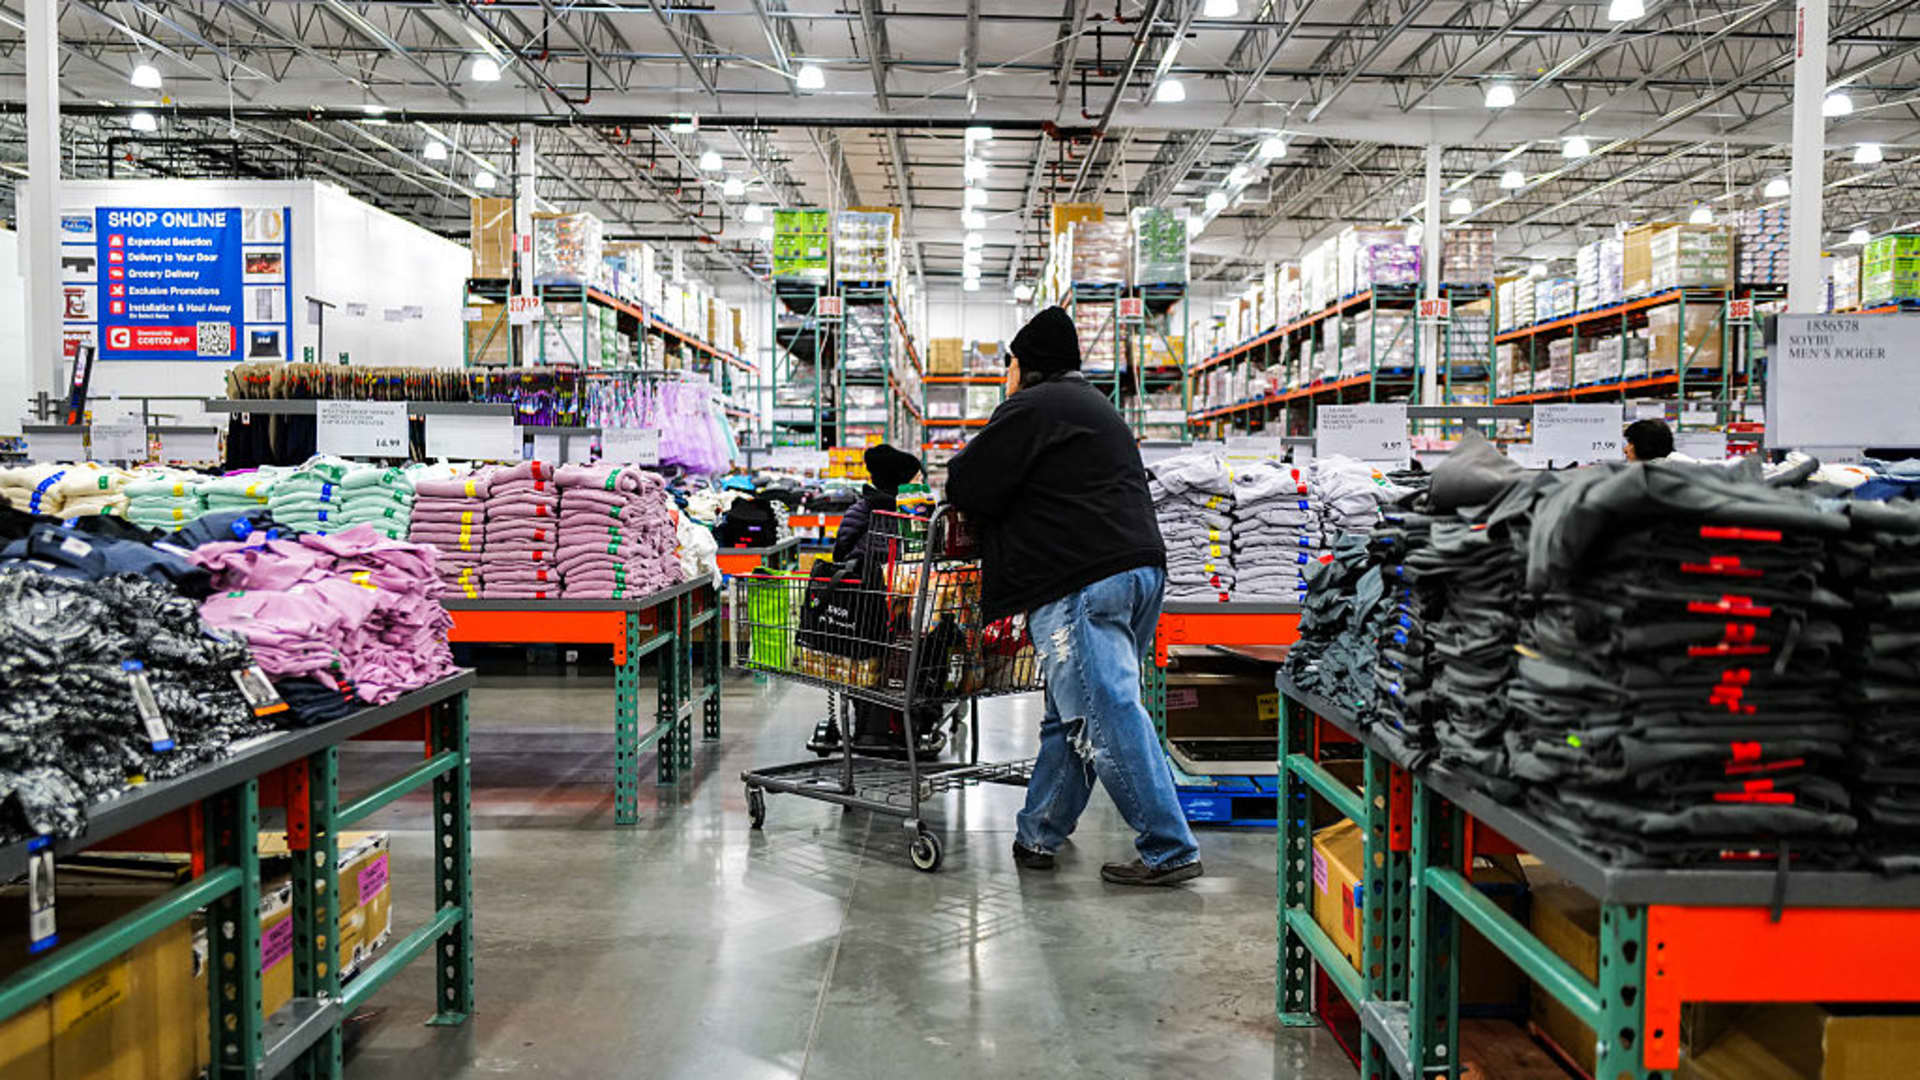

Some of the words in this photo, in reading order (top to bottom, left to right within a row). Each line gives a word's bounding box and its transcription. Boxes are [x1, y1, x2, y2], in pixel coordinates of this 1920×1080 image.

[108, 211, 157, 228] SHOP
[162, 211, 227, 228] ONLINE
[127, 236, 171, 247] Expanded
[172, 236, 213, 246] Selection
[127, 253, 163, 263] Delivery
[175, 253, 195, 262] Your
[196, 253, 219, 262] Door
[128, 269, 163, 280] Grocery
[164, 269, 200, 281] Delivery
[128, 286, 169, 296] Exclusive
[170, 286, 220, 296] Promotions
[128, 303, 175, 313] Installation
[177, 303, 184, 313] &
[186, 303, 206, 313] Haul
[207, 303, 232, 314] Away
[1730, 301, 1750, 317] 305
[137, 337, 172, 346] COSTCO
[173, 337, 190, 346] APP
[1789, 335, 1834, 346] SOYBU
[1789, 348, 1831, 359] MEN'S
[1834, 348, 1886, 359] JOGGER
